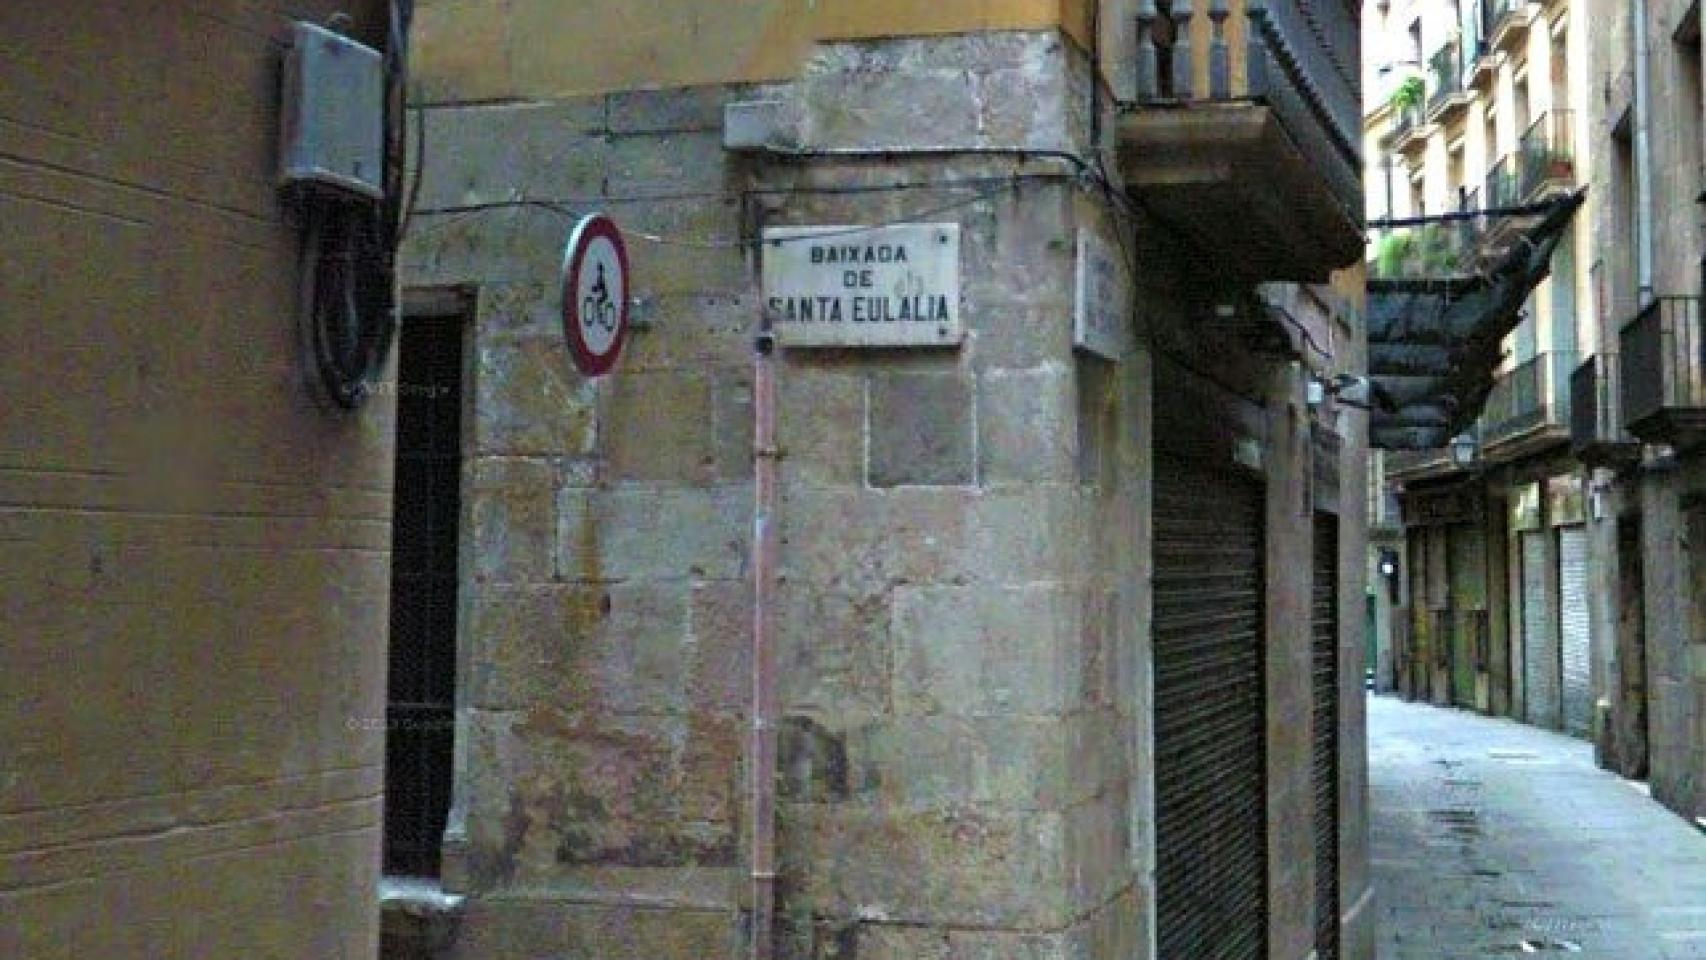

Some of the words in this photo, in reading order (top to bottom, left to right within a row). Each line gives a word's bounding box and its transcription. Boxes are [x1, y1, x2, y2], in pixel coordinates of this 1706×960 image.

[811, 245, 908, 264] BAIXADA
[843, 269, 875, 288] DE
[768, 295, 842, 322] SANTA
[853, 295, 949, 322] EULALIA
